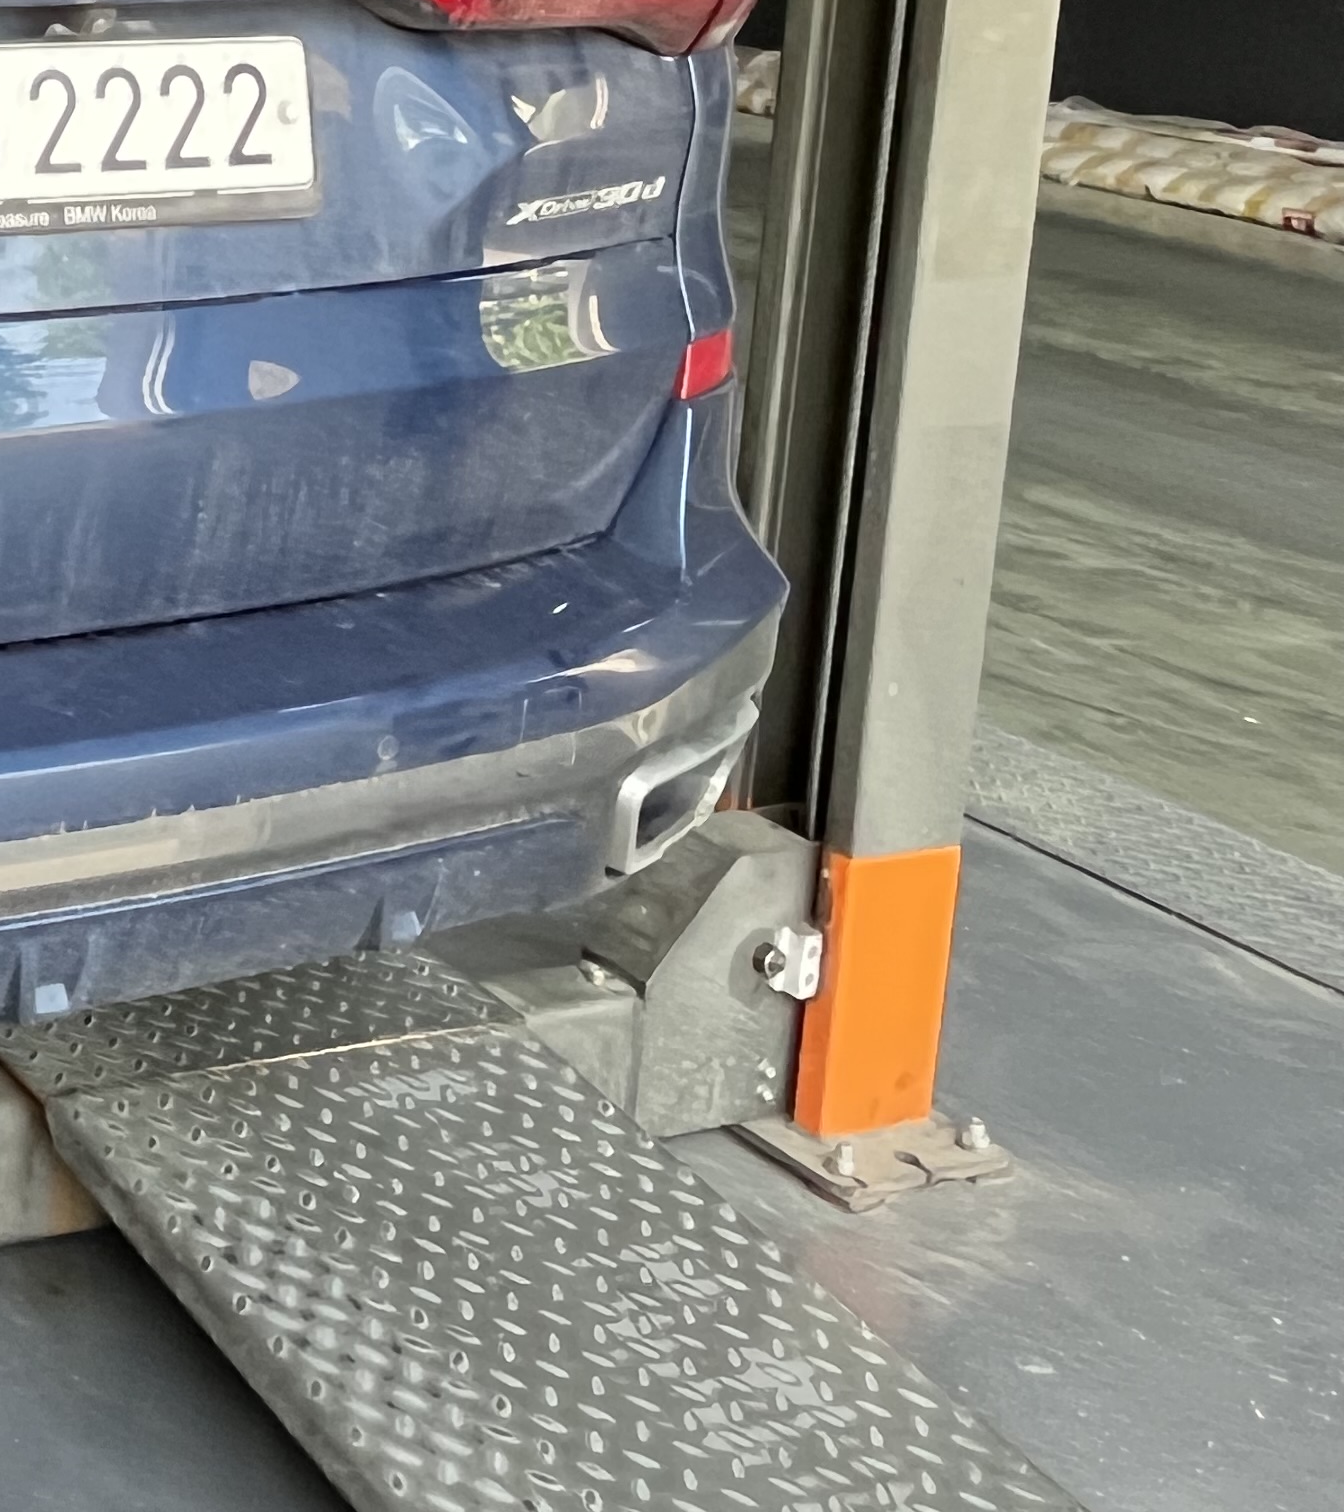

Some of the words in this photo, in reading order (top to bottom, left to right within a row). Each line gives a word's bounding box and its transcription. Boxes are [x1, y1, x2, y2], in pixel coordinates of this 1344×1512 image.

[28, 62, 274, 177] 2222
[64, 205, 108, 226] BMW
[112, 203, 158, 223] Korea
